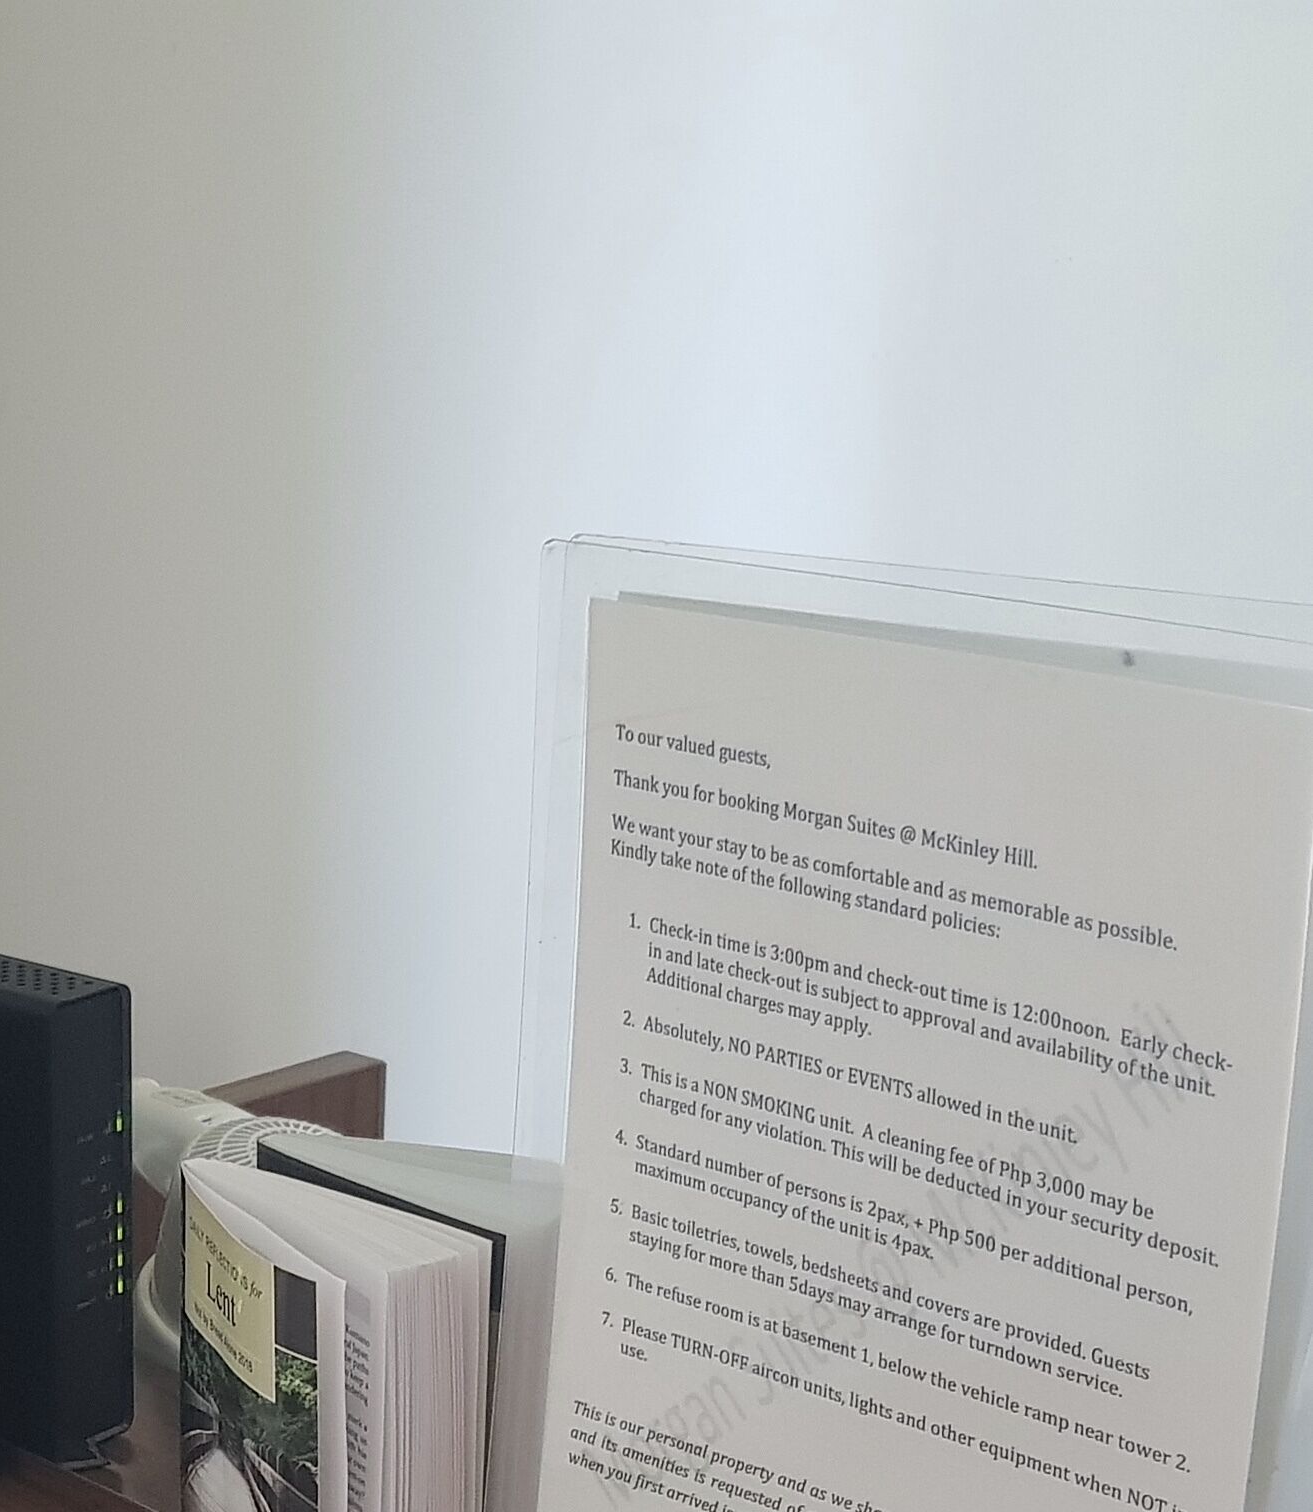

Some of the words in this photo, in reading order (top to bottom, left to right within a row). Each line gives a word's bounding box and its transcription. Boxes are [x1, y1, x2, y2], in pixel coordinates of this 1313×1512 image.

[614, 722, 635, 743] To
[636, 731, 664, 748] our
[665, 733, 716, 758] valued
[717, 745, 771, 771] guests,
[612, 767, 660, 794] Thank
[660, 781, 690, 800] you
[692, 782, 716, 804] for
[717, 787, 780, 822] booking
[782, 800, 843, 831] Morgan
[845, 813, 896, 841] Suites
[899, 824, 917, 846] @
[920, 827, 1000, 866] McKinley
[1003, 844, 1038, 870] Hill.
[629, 911, 642, 930] 1.
[648, 916, 713, 947] Check-in
[715, 932, 751, 955] time
[753, 939, 767, 959] is
[769, 943, 830, 974] 3:00pm
[832, 962, 863, 982] and
[866, 966, 948, 1002] check-out
[950, 987, 989, 1012] time
[992, 996, 1008, 1017] is
[1012, 1001, 1111, 1043] 12:00noon.
[1119, 1026, 1169, 1061] Early
[1171, 1041, 1233, 1072] check-
[621, 1008, 636, 1028] 2.
[642, 1014, 725, 1053] Absolutely,
[727, 1035, 752, 1057] NO
[754, 1041, 824, 1076] PARTIES
[825, 1064, 845, 1081] or
[847, 1065, 914, 1100] EVENTS
[915, 1085, 983, 1119] allowed
[985, 1102, 1003, 1124] in
[1006, 1109, 1036, 1133] the
[1038, 1121, 1078, 1145] unit.
[206, 1260, 238, 1327] Lent
[249, 1280, 264, 1300] for
[628, 1229, 682, 1261] staying
[682, 1242, 707, 1264] for
[708, 1253, 748, 1277] more
[750, 1263, 785, 1289] than
[787, 1274, 835, 1305] 5days
[836, 1294, 872, 1319] may
[872, 1306, 937, 1338] arrange
[939, 1322, 967, 1346] for
[968, 1333, 1053, 1375] turndown
[1055, 1364, 1124, 1399] service.
[619, 1342, 648, 1362] use.
[601, 1309, 614, 1328] 7.
[621, 1316, 668, 1346] Please
[669, 1331, 750, 1371] TURN-OFF
[750, 1361, 800, 1389] aircon
[802, 1379, 846, 1407] units,
[848, 1390, 893, 1420] lights
[895, 1410, 927, 1433] and
[929, 1422, 977, 1448] other
[978, 1439, 1072, 1483] equipment
[1073, 1471, 1122, 1501] when
